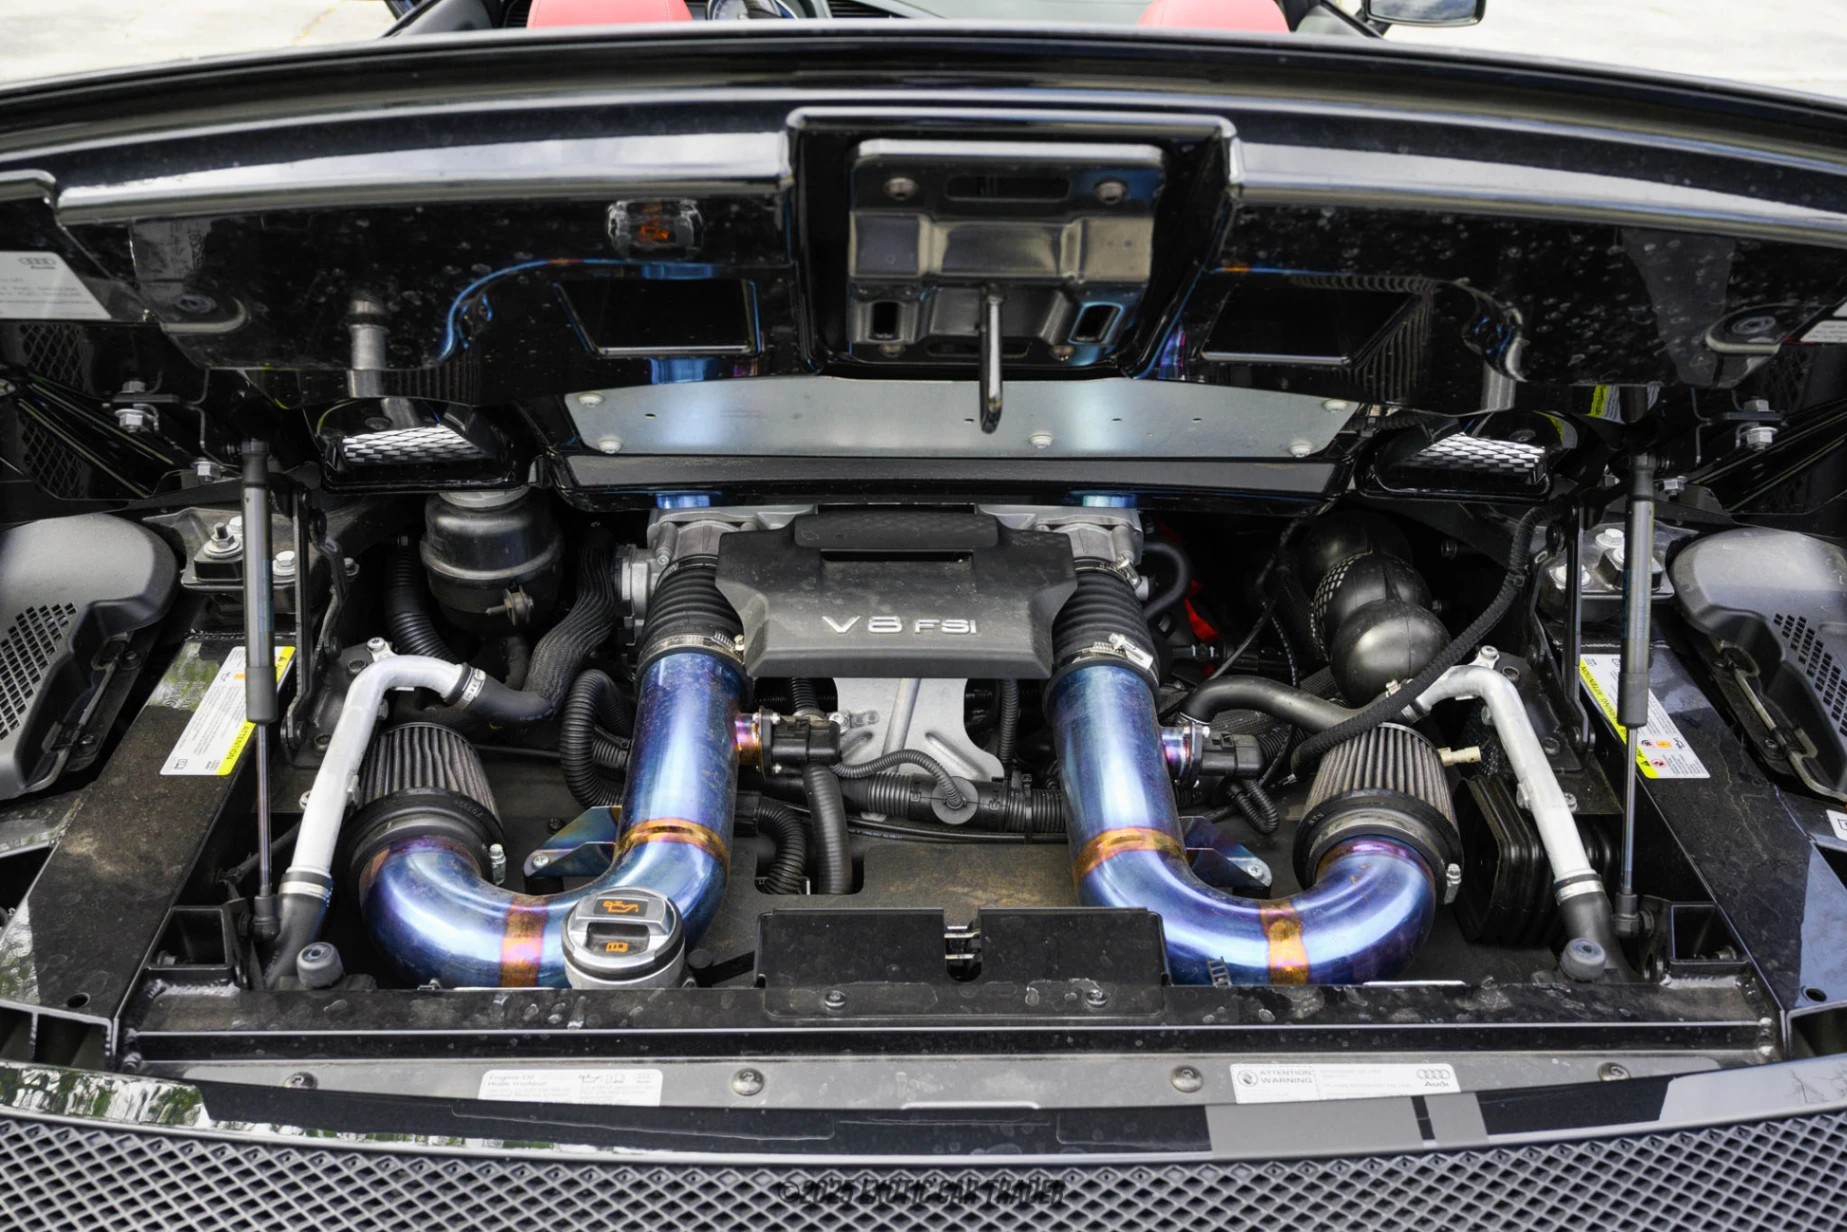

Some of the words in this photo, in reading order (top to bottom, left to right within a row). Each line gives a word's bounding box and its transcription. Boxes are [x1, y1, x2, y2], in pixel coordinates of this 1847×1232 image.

[822, 615, 902, 634] V8
[915, 618, 977, 634] FSI
[226, 725, 250, 760] ATTENTION
